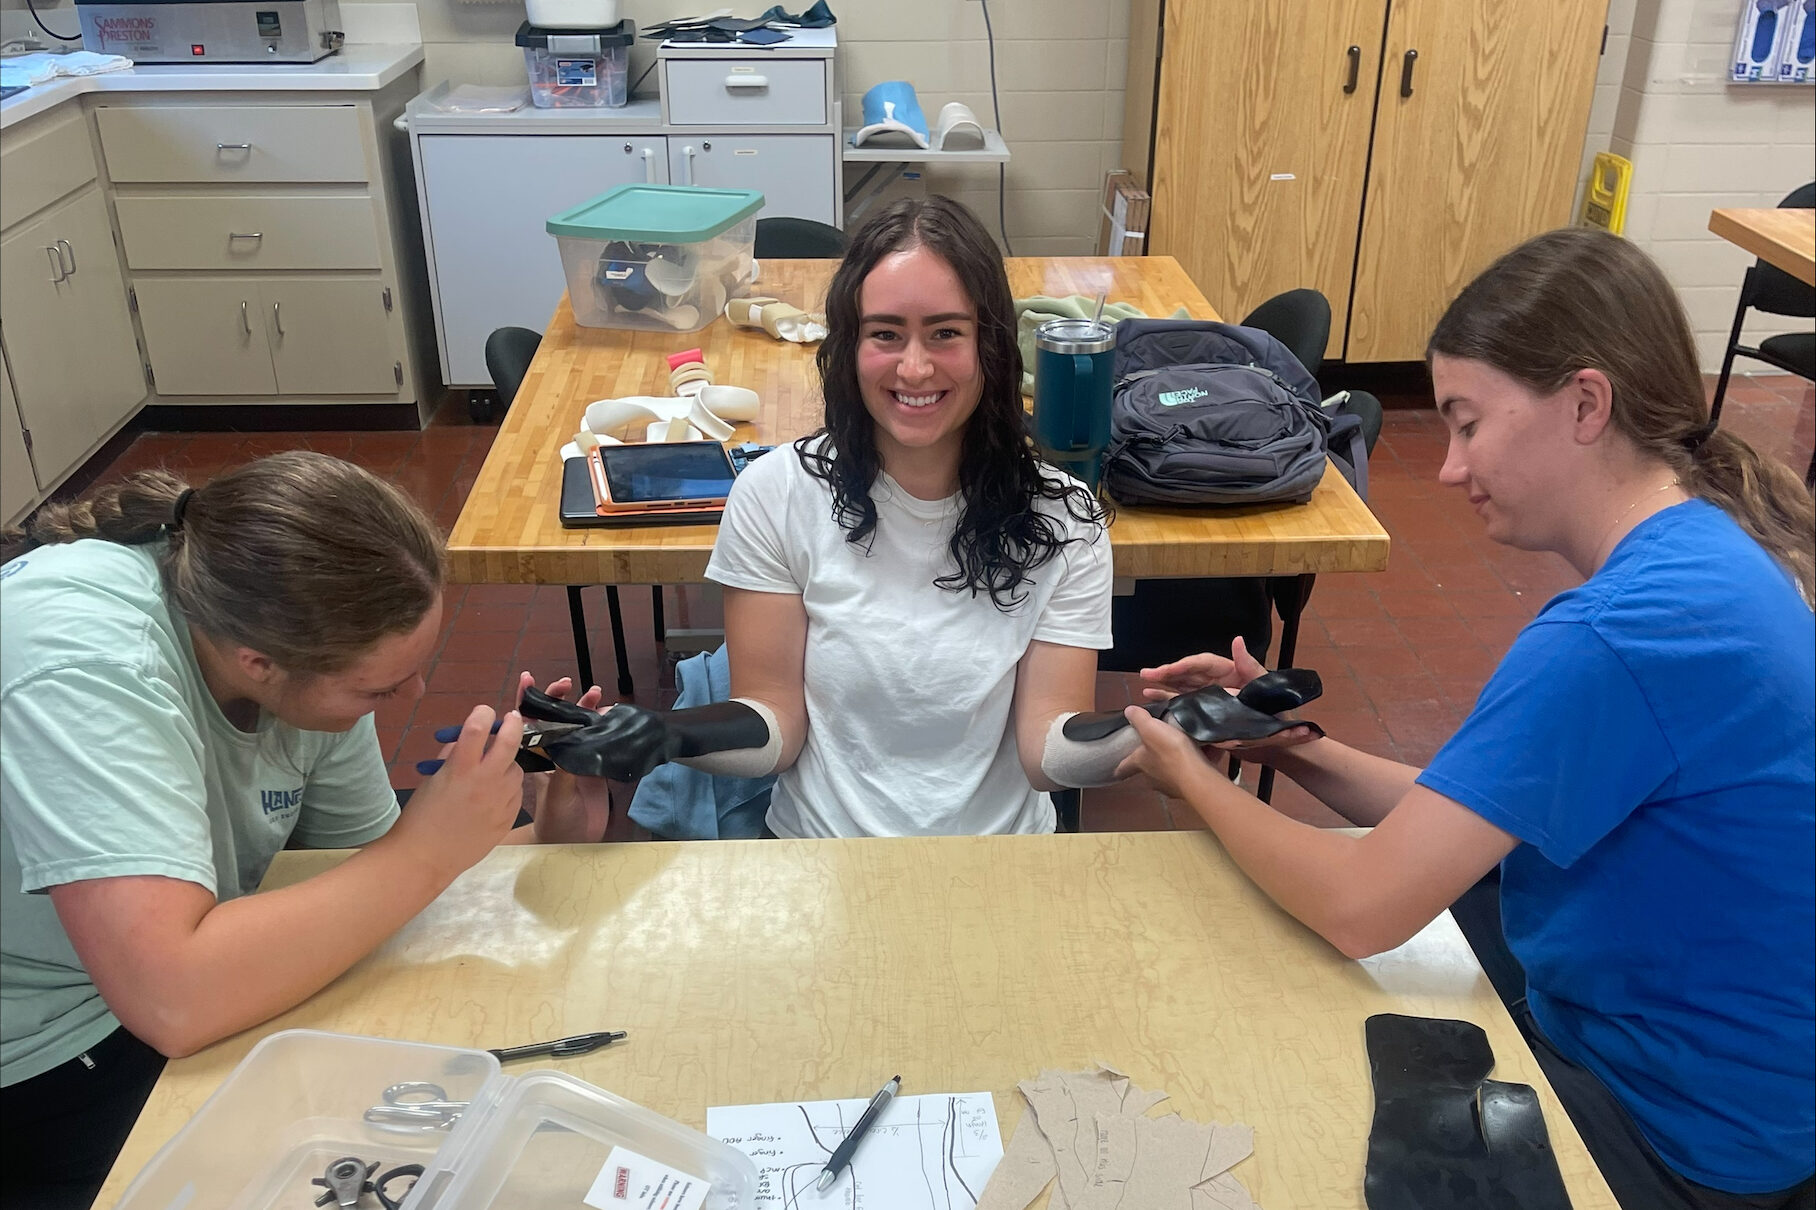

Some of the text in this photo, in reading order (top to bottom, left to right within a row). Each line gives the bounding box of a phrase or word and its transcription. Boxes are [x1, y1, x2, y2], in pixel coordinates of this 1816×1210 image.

[94, 16, 155, 31] SAMMONS
[98, 30, 151, 46] PRESTON
[615, 1168, 627, 1198] WARNING
